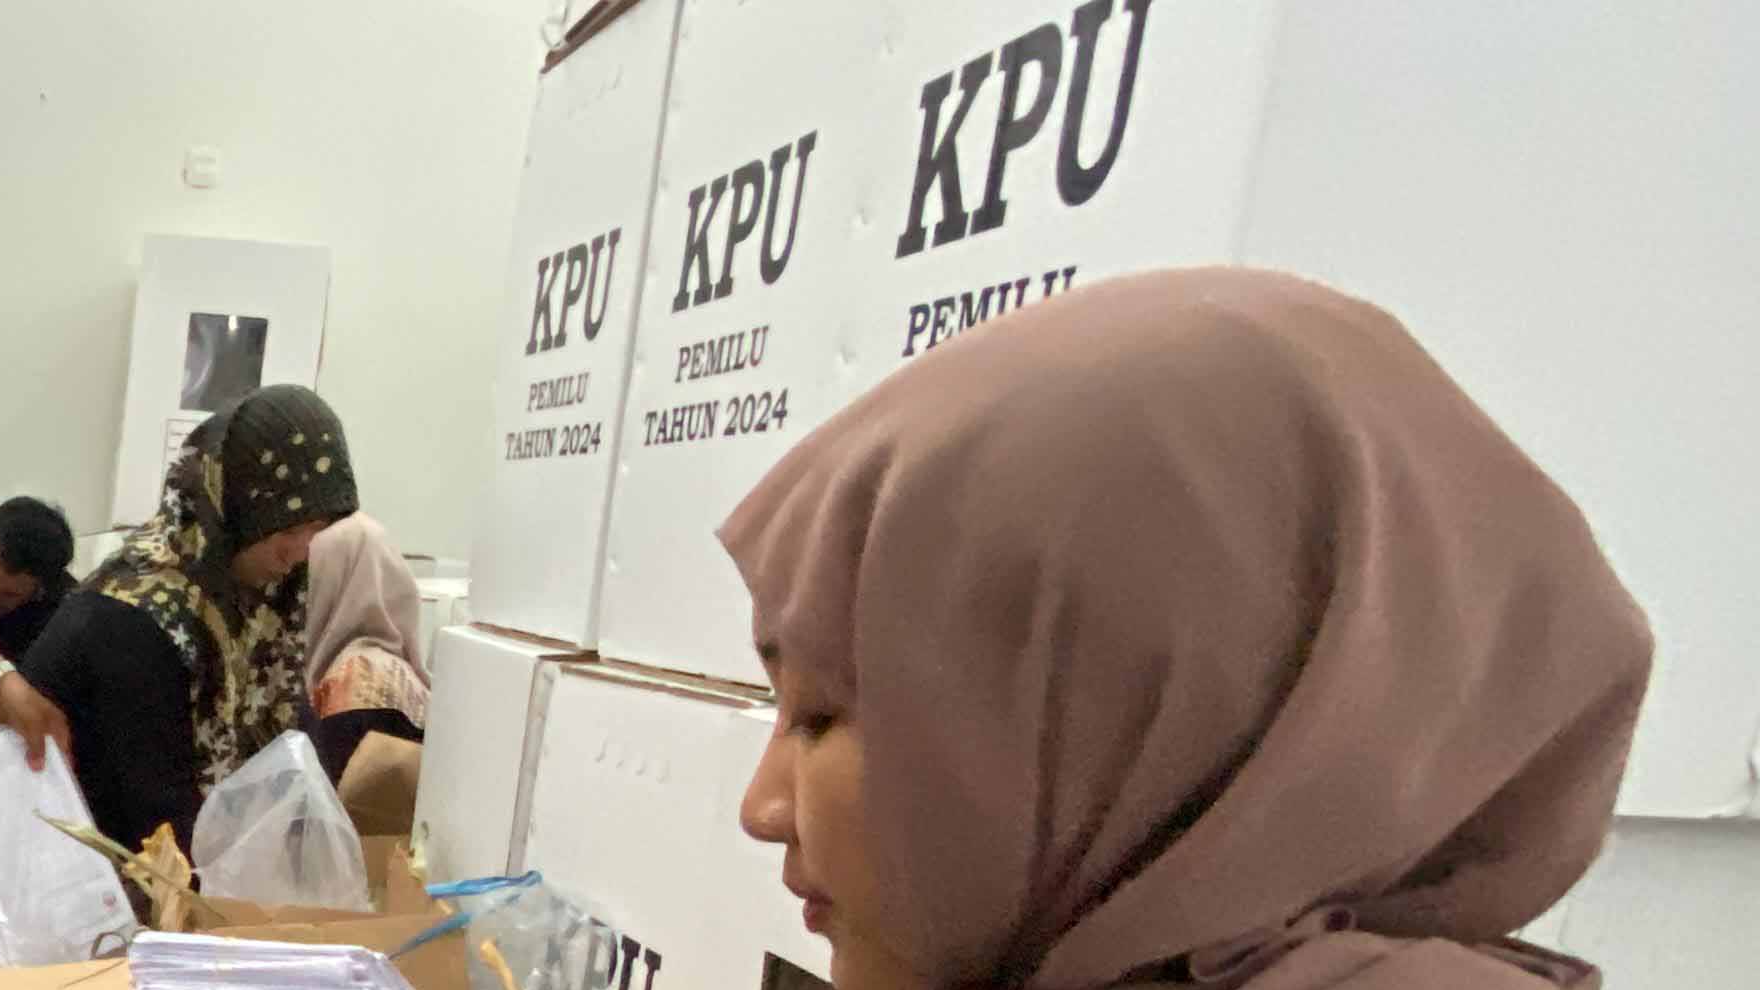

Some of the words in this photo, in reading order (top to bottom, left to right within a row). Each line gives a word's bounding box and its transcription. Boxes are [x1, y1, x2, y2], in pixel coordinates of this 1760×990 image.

[895, 0, 1153, 259] KPU
[672, 129, 818, 313] KPU
[525, 227, 622, 356] KPU
[675, 325, 769, 383] PEMILU
[527, 371, 590, 412] PEMILU
[644, 400, 720, 447] TAHUN
[723, 387, 789, 436] 2024
[505, 427, 557, 461] TAHUN
[559, 421, 602, 457] 2024
